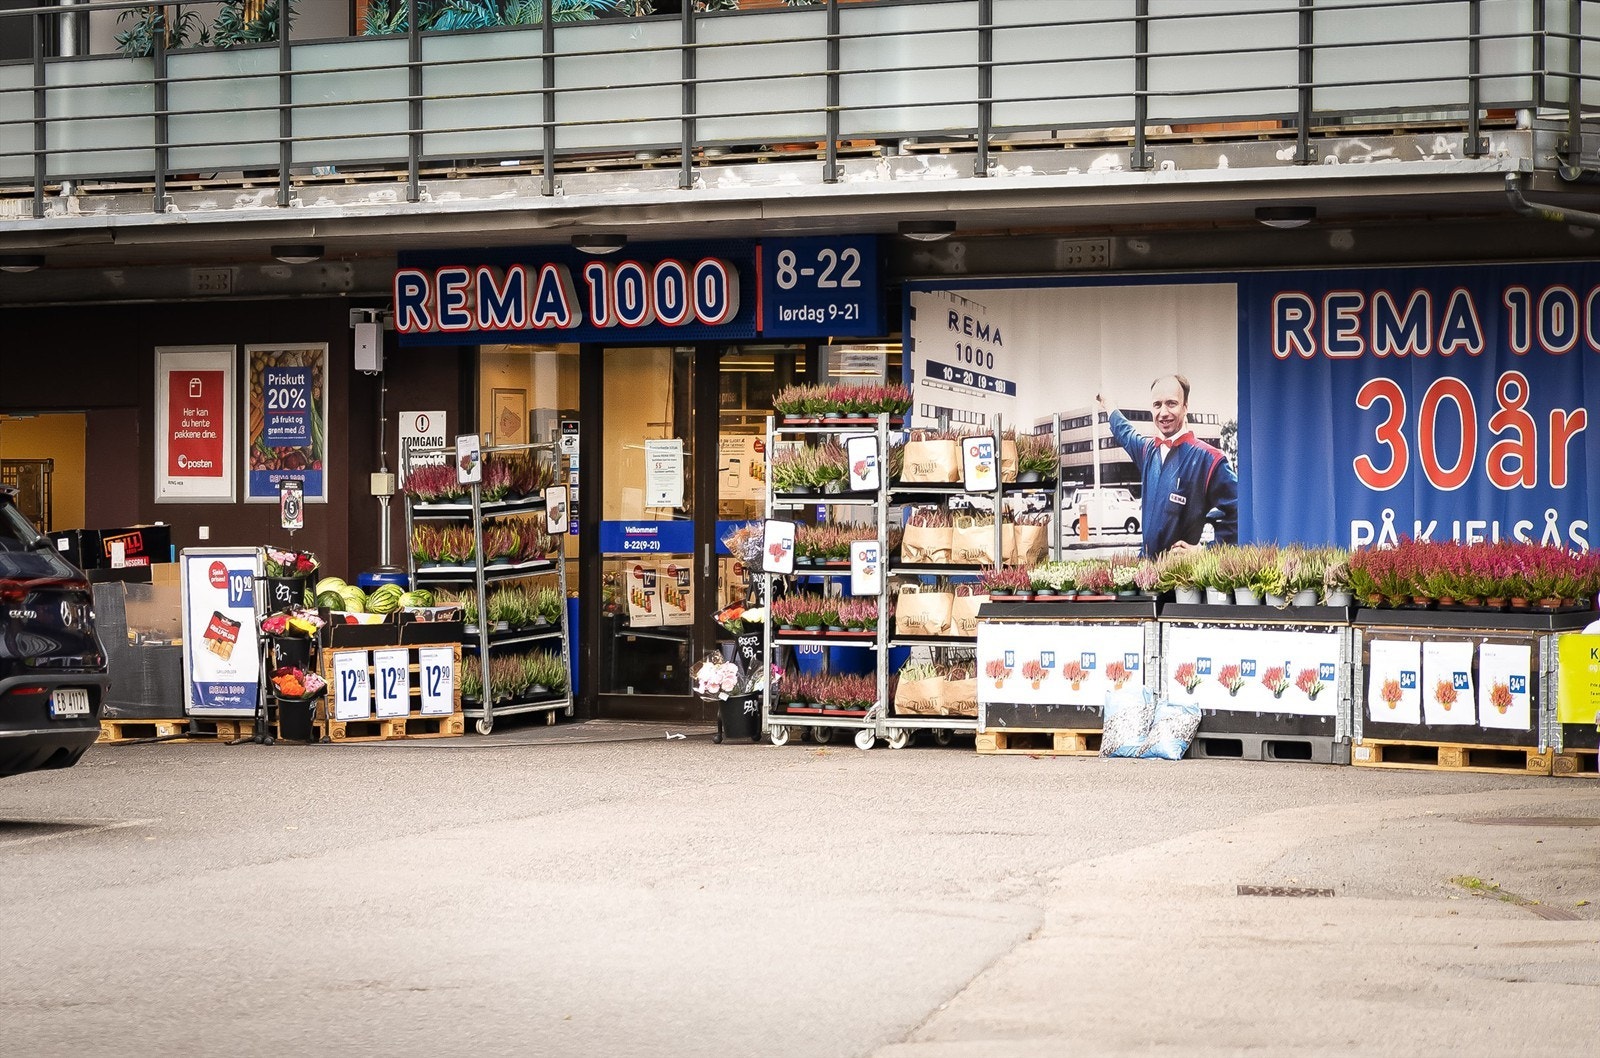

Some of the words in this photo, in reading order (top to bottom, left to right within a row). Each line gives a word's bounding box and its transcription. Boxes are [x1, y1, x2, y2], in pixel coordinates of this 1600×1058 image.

[776, 248, 862, 290] 8-22
[394, 263, 571, 333] REMA
[584, 257, 733, 328] 1000
[779, 305, 823, 322] lørdag
[829, 304, 860, 321] 9-21
[948, 310, 1003, 346] REMA
[1271, 287, 1486, 360] REMA
[956, 343, 994, 370] 1000
[268, 374, 305, 385] Priskutt
[268, 388, 306, 409] 20%
[183, 408, 195, 416] Her
[196, 408, 208, 416] kan
[182, 419, 190, 427] du
[191, 419, 210, 427] hente
[272, 416, 279, 424] på
[175, 430, 201, 440] pakkene
[202, 430, 217, 438] dine.
[268, 427, 283, 435] grønt
[188, 460, 212, 469] posten
[289, 501, 295, 514] 5
[1351, 508, 1399, 551] PÅ
[624, 541, 661, 550] 8-22(9-21)
[209, 686, 229, 694] REMA
